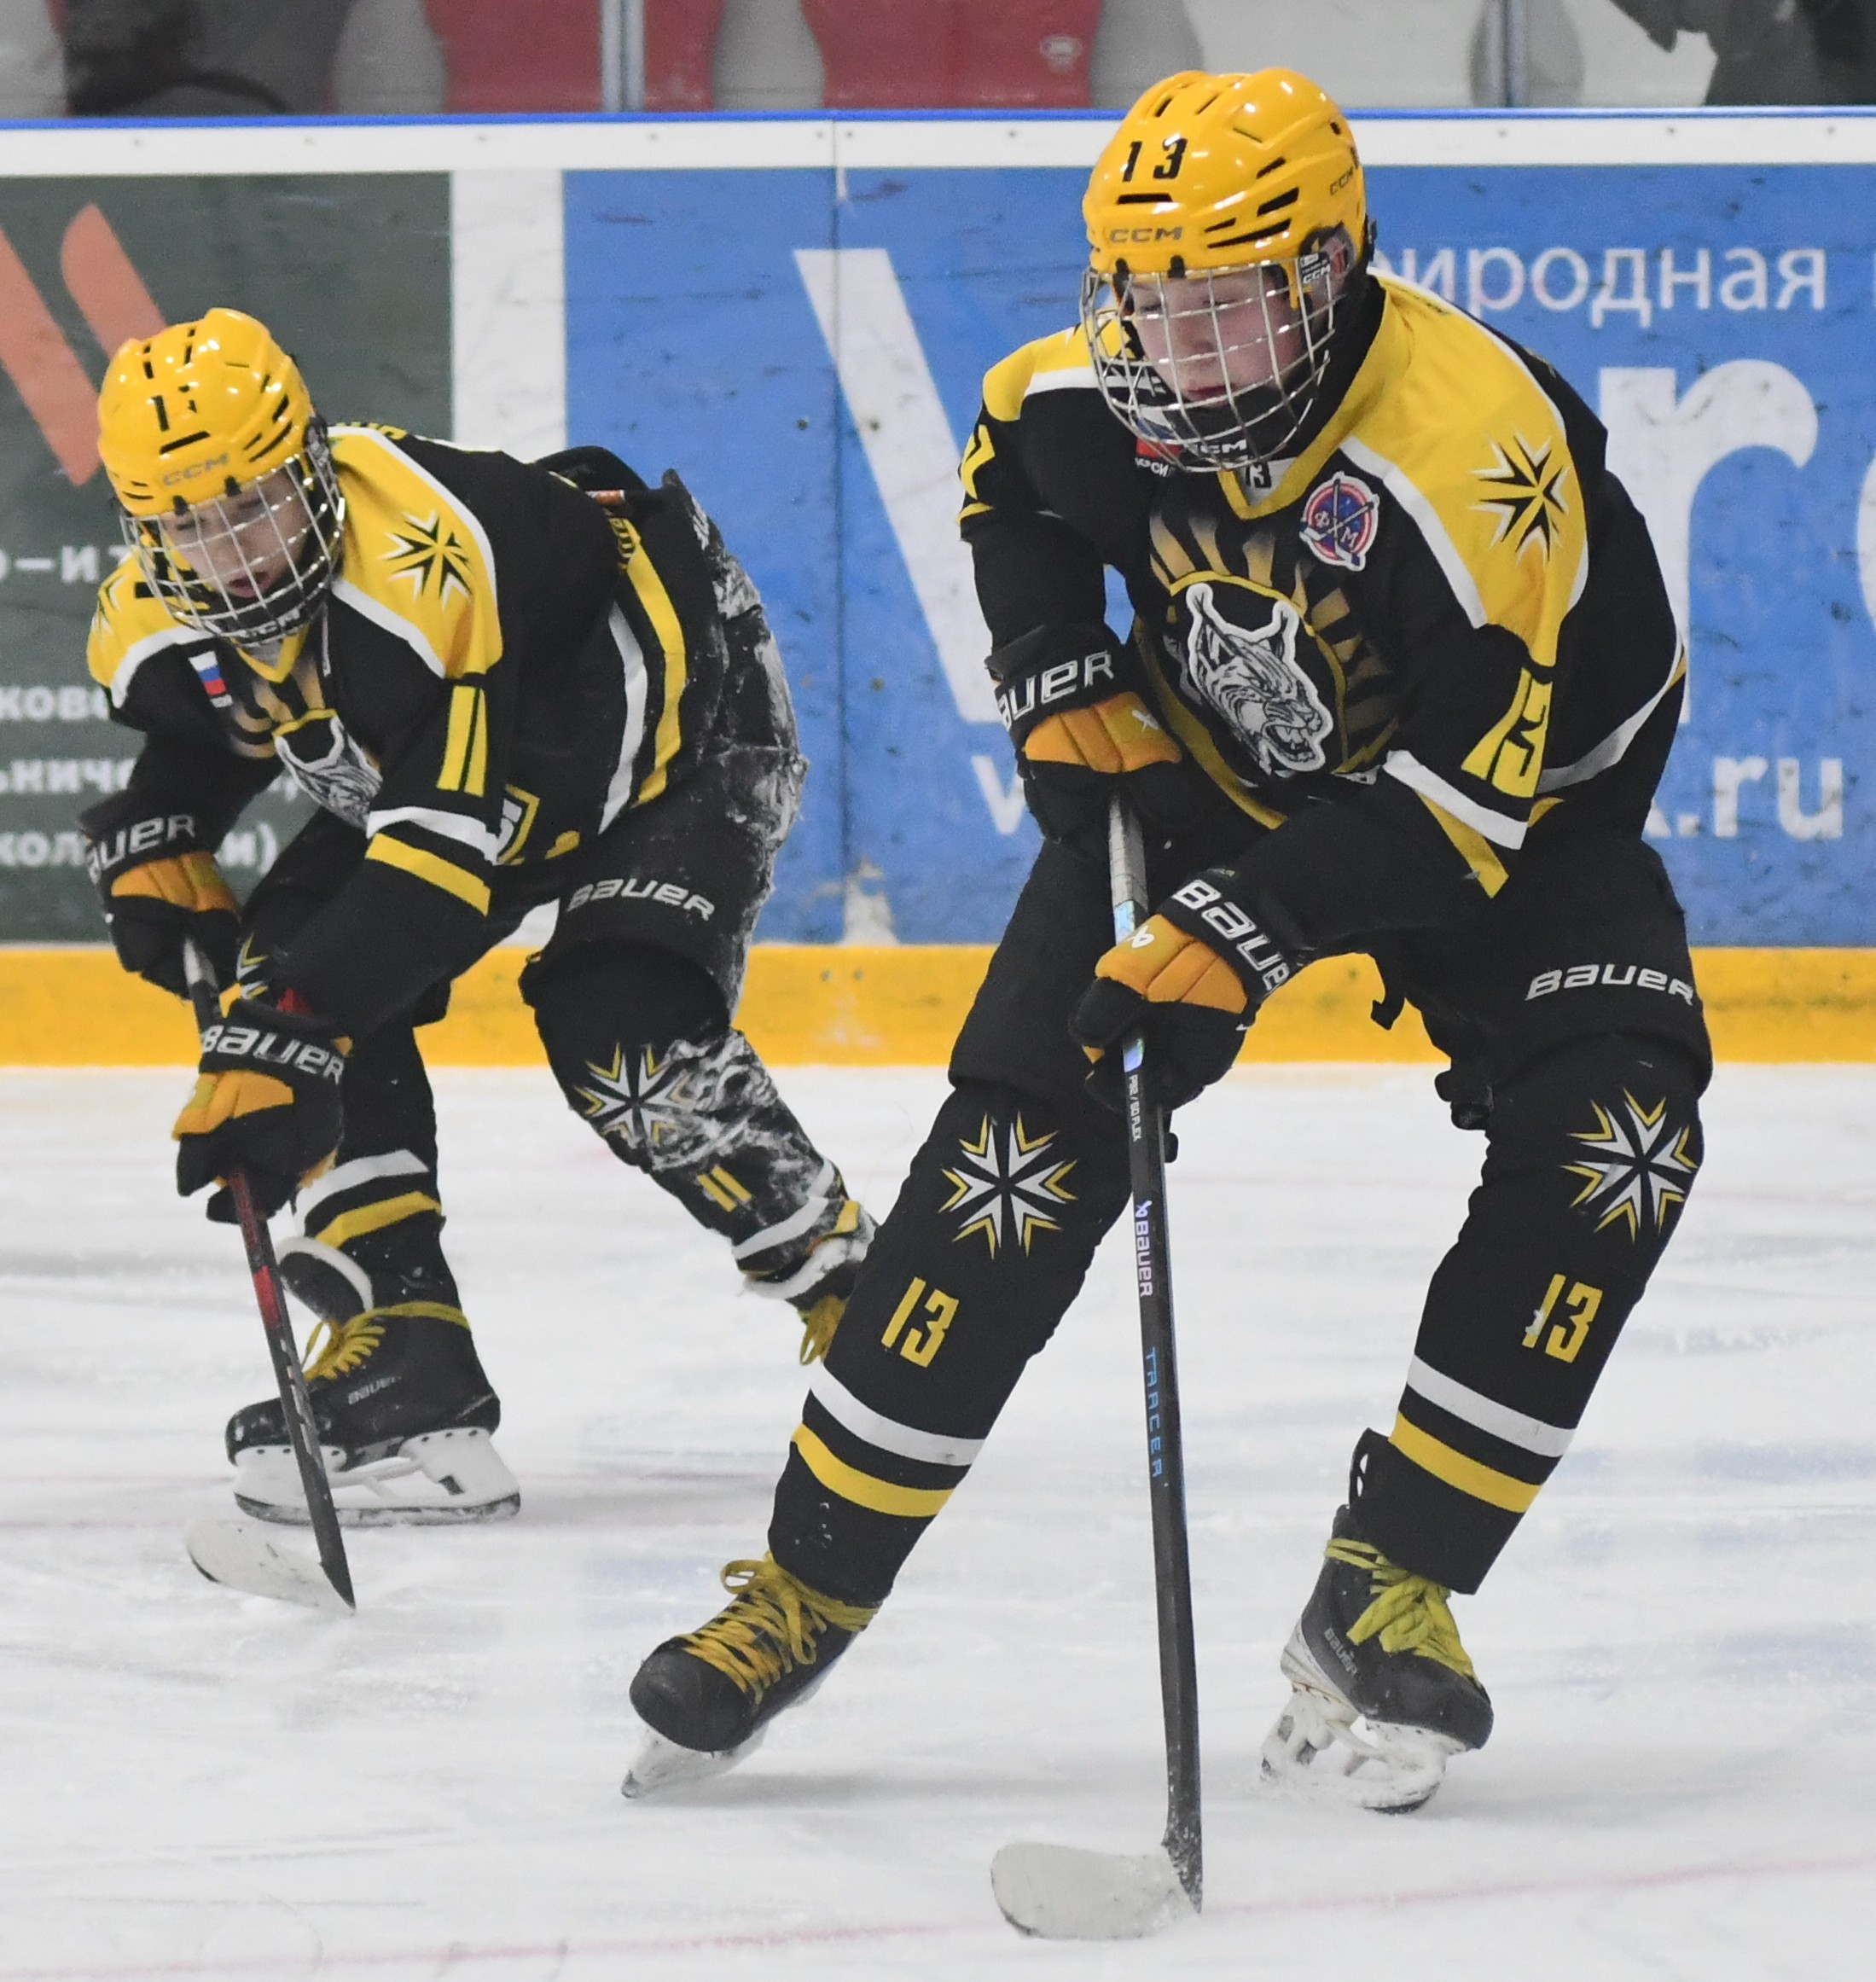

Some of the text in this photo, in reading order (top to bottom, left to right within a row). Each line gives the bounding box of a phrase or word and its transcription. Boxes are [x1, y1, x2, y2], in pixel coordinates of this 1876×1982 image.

[1122, 137, 1187, 182] 13
[1110, 226, 1182, 243] CCM
[1375, 239, 1827, 328] иродная
[163, 452, 229, 486] CCM
[996, 649, 1114, 732] AUER
[1461, 666, 1554, 798] 13
[436, 685, 489, 798] 11
[86, 814, 195, 886] AUER
[1171, 879, 1291, 991] BAUE
[1525, 963, 1694, 1006] BAUER
[696, 1165, 752, 1212] 11
[881, 1276, 960, 1369] 13
[1521, 1273, 1603, 1364] 13
